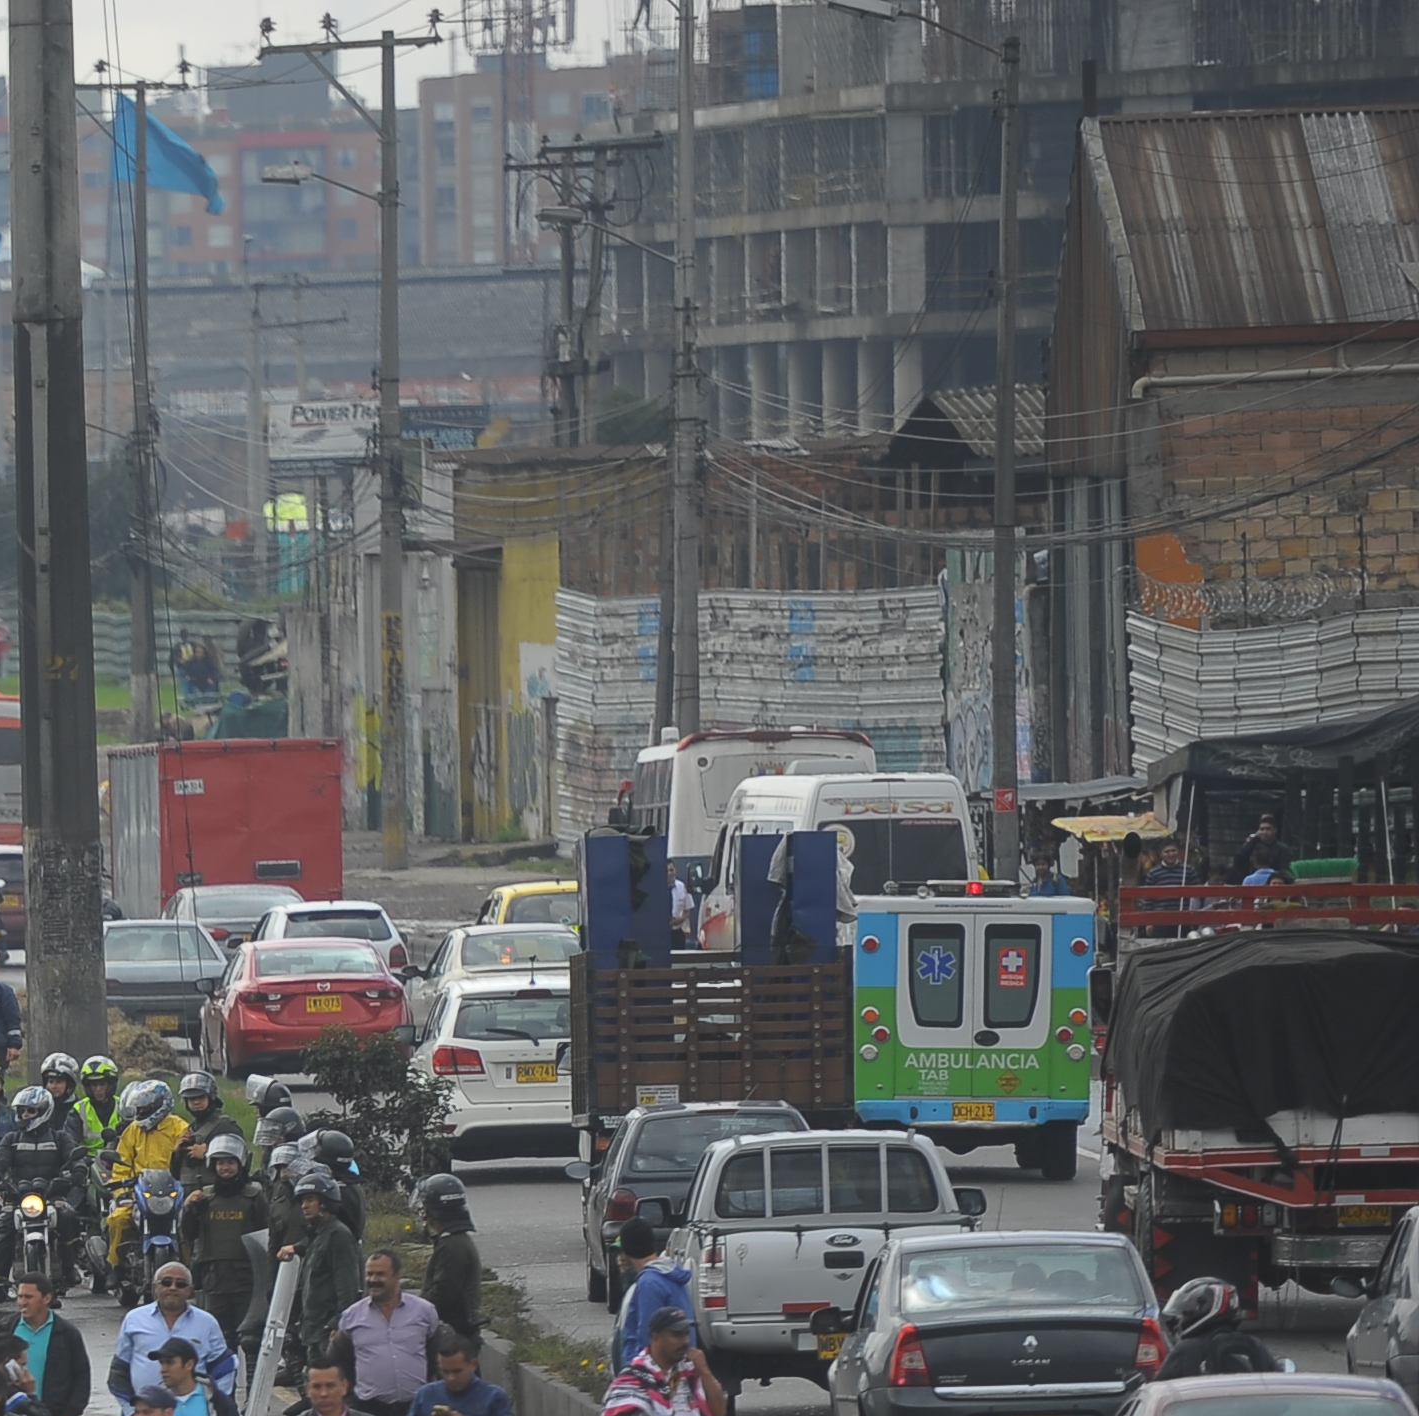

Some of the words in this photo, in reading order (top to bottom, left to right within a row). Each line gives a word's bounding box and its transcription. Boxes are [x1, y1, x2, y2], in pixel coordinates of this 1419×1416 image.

[904, 1053, 1039, 1069] AMBULANCIA
[517, 1064, 555, 1077] RMX-741
[918, 1070, 949, 1080] TAB
